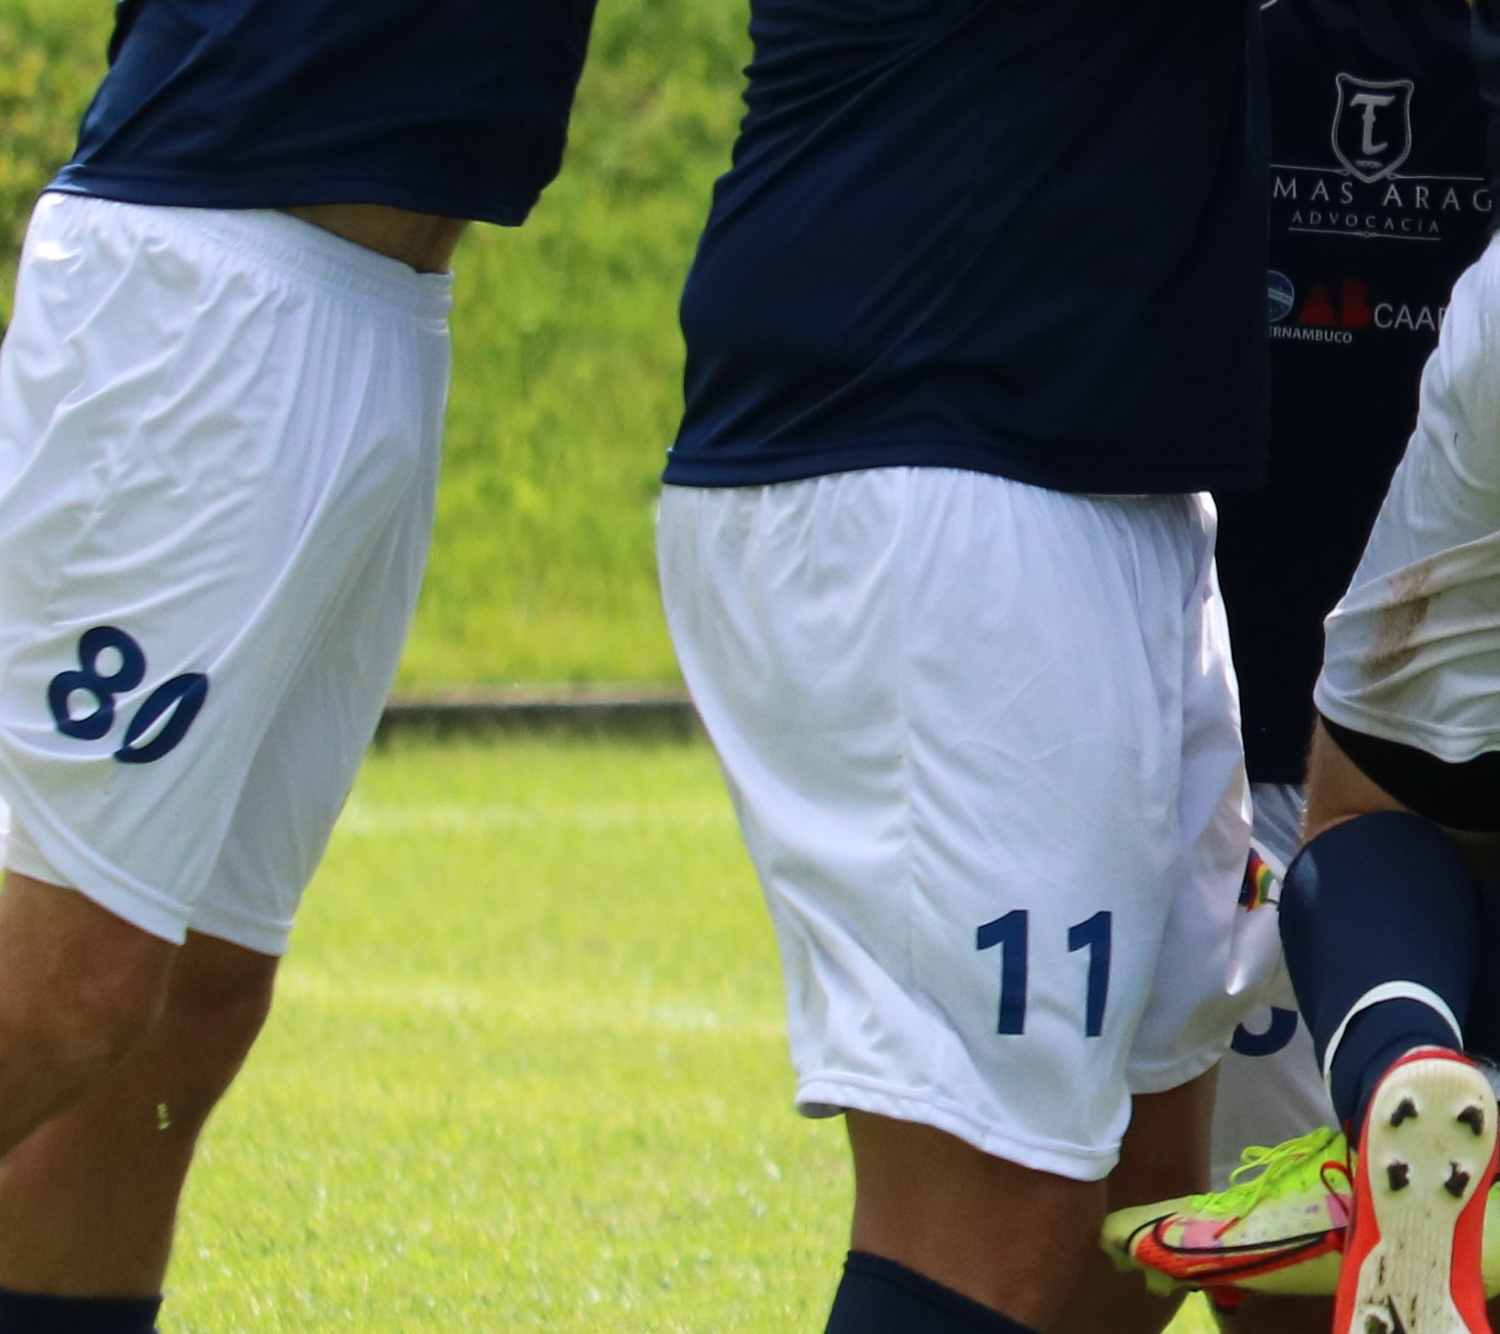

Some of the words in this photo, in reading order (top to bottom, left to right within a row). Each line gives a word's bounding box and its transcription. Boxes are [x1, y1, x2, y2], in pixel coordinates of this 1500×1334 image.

[1291, 210, 1440, 233] ADVOCACIA
[48, 625, 209, 764] 80
[976, 909, 1113, 1038] 11
